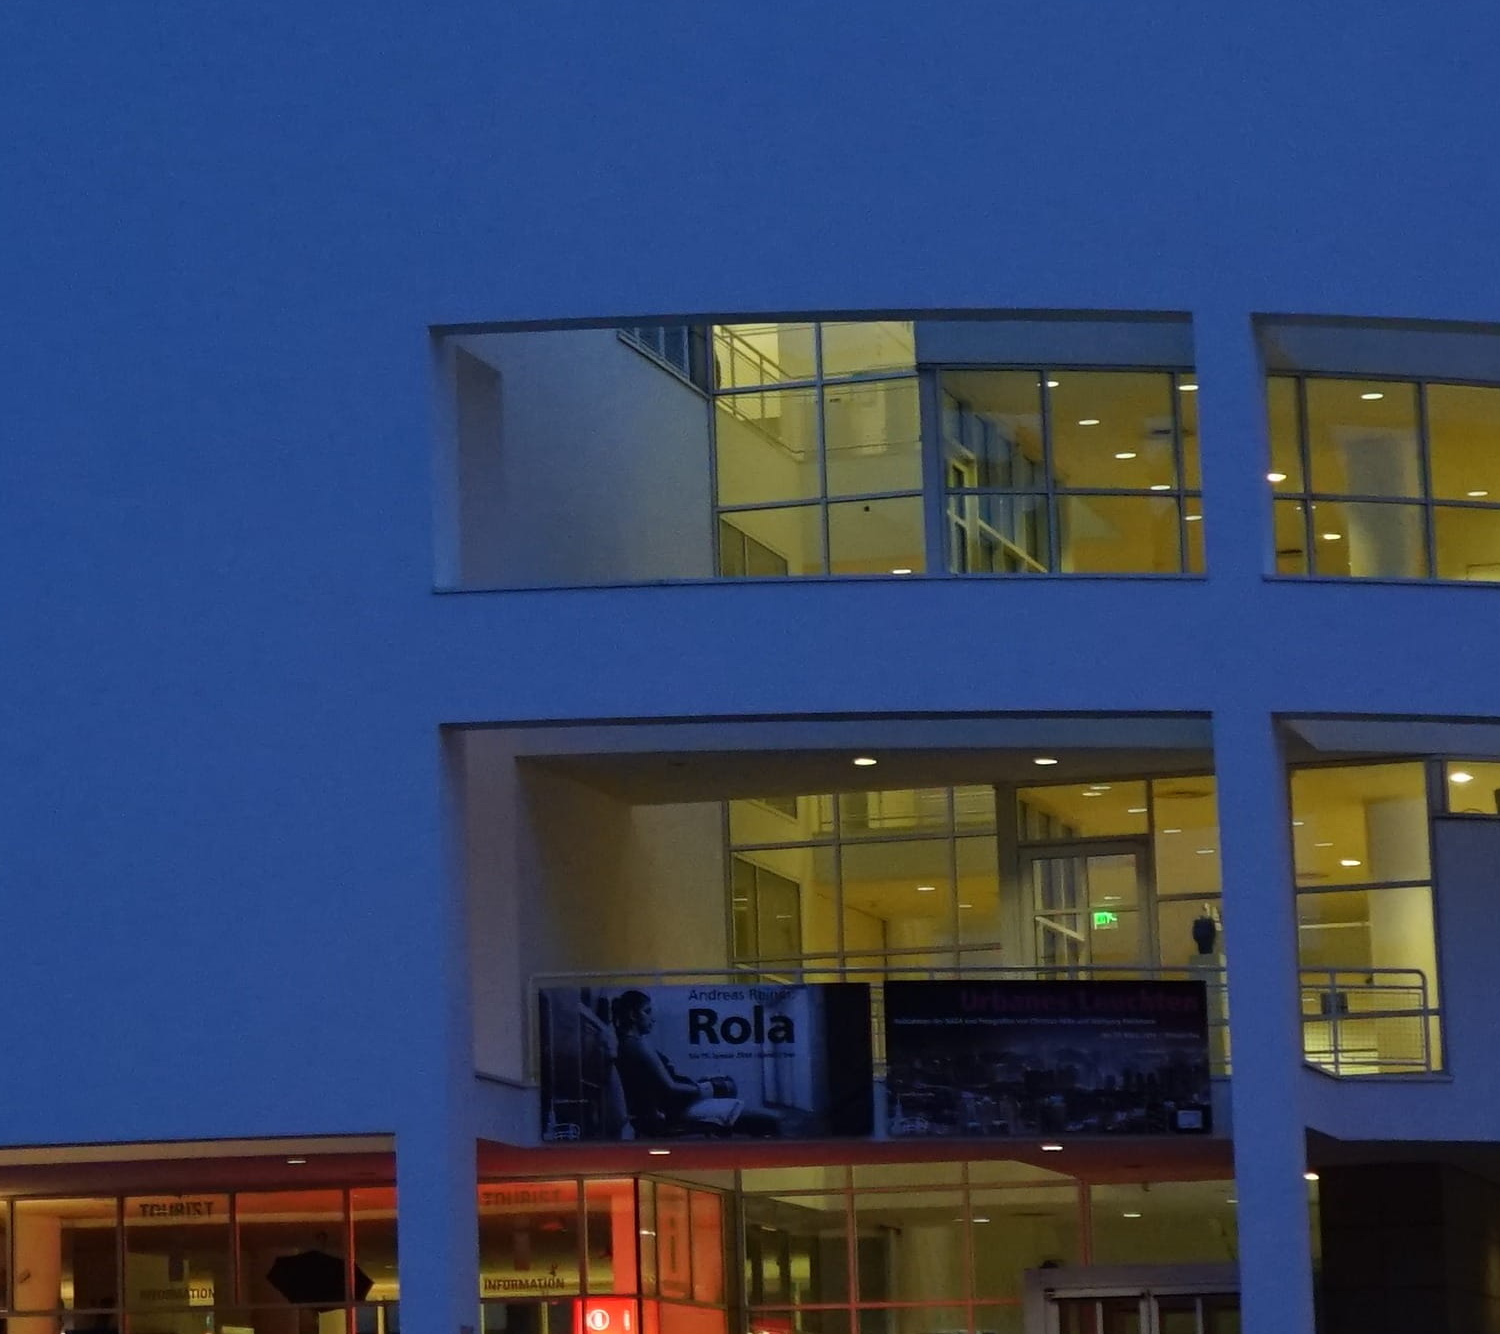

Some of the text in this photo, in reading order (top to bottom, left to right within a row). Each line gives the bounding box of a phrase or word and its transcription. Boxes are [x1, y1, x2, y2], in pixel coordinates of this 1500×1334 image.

[688, 988, 746, 1002] Andreas
[688, 1004, 796, 1045] Rola
[139, 1201, 214, 1218] TOURIST
[484, 1277, 565, 1291] INFORMATION
